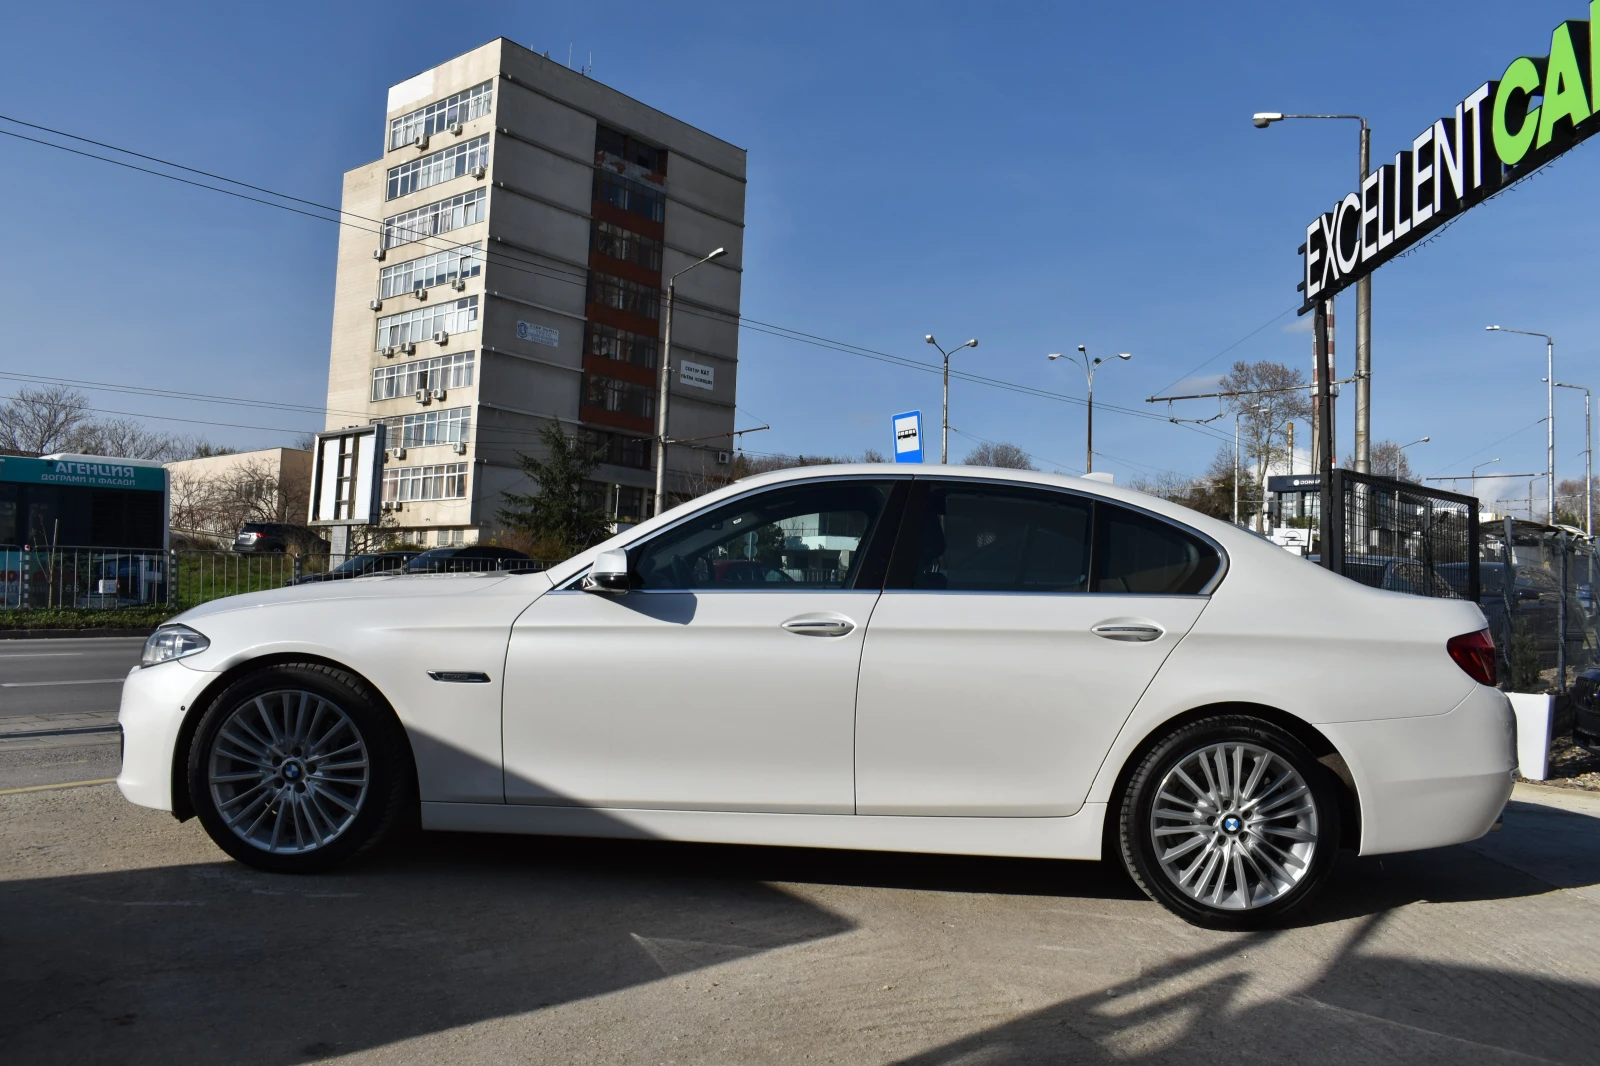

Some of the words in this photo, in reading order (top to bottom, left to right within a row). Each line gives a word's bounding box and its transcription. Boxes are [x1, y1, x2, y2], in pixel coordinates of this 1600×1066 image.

[1306, 81, 1490, 300] EXCELLENT
[55, 461, 135, 478] АГЕНЦИЯ
[41, 473, 86, 483] ДОГРАМИ
[89, 475, 96, 483] И
[98, 477, 136, 486] ФАСАДИ
